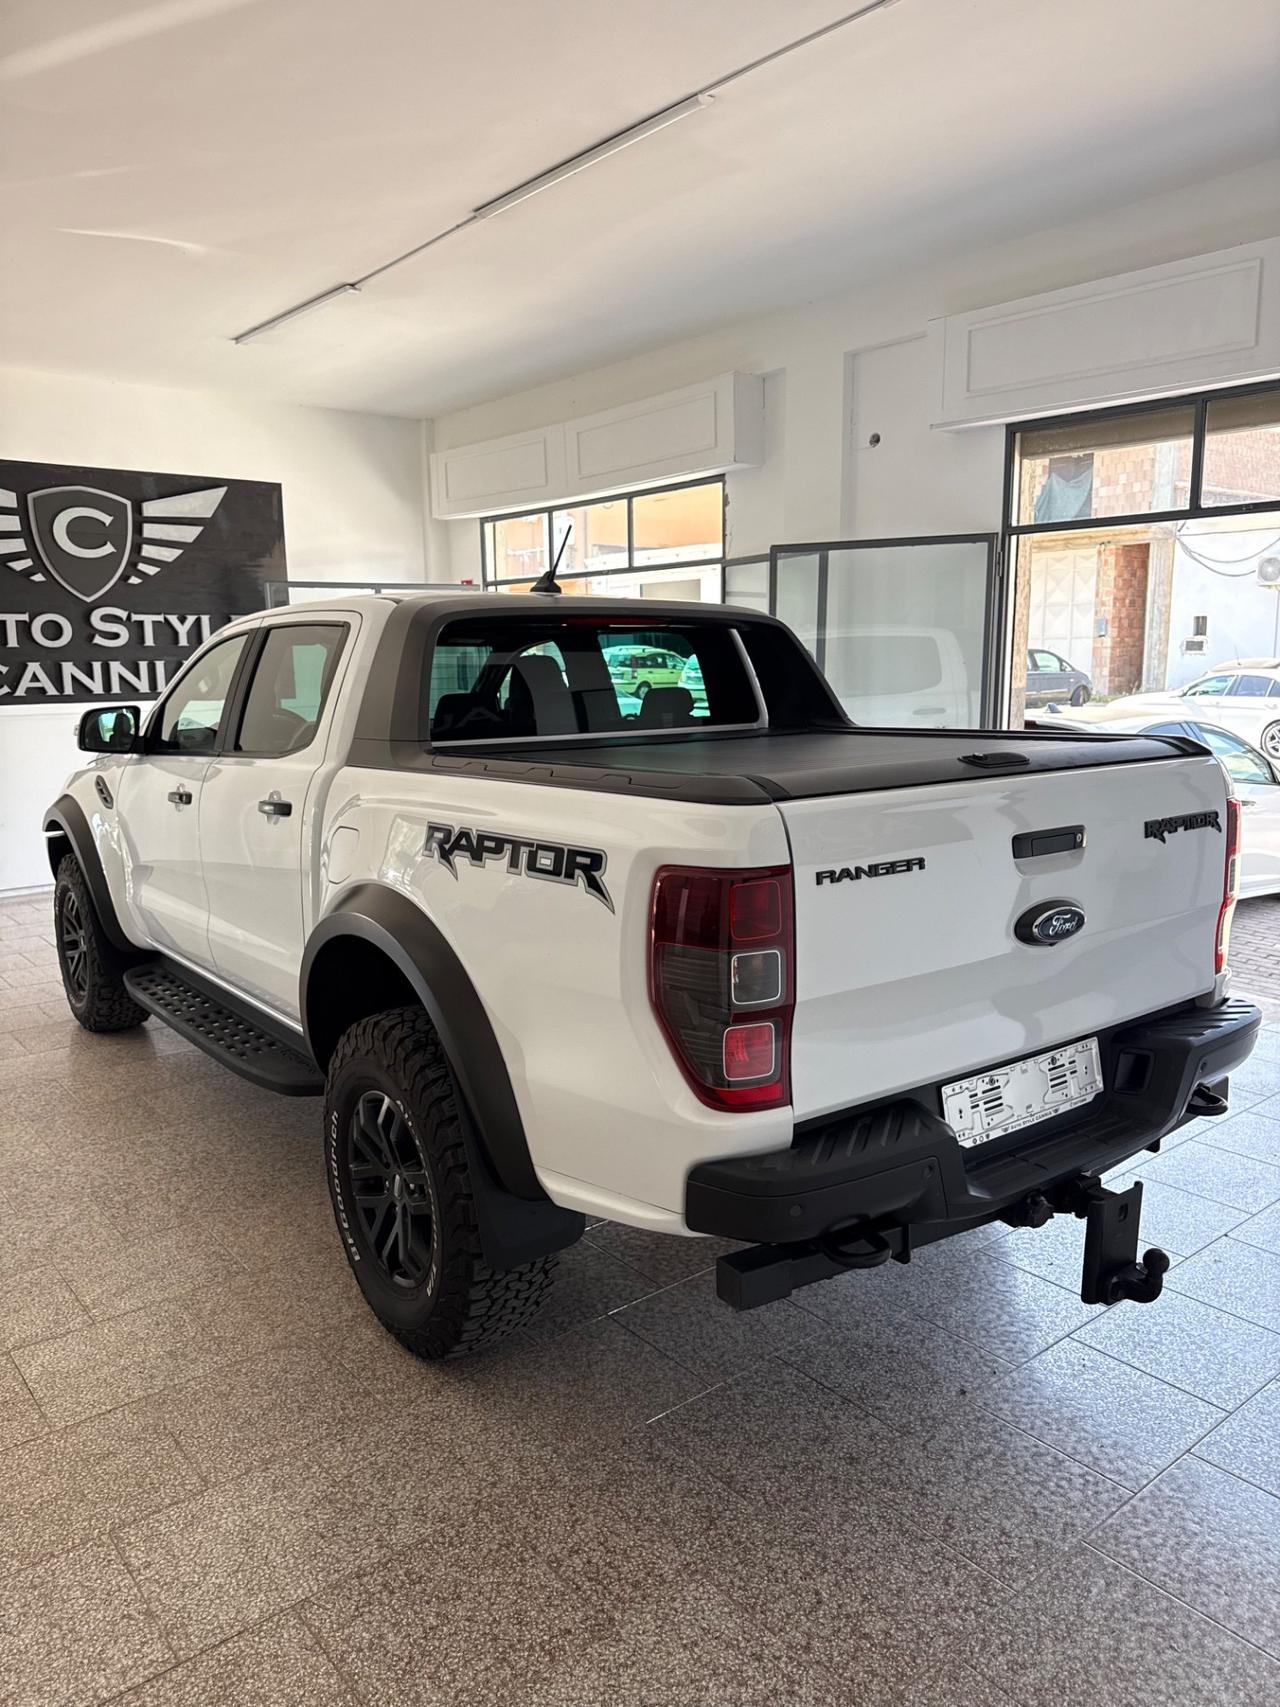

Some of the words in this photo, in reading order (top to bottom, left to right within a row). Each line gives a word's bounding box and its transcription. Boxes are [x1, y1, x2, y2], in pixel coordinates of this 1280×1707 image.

[52, 506, 117, 558] C
[89, 606, 238, 648] STYL
[1144, 810, 1222, 844] RAPTOR
[422, 821, 616, 915] RAPTOR
[815, 856, 926, 886] RANGER
[1049, 913, 1079, 936] Ford
